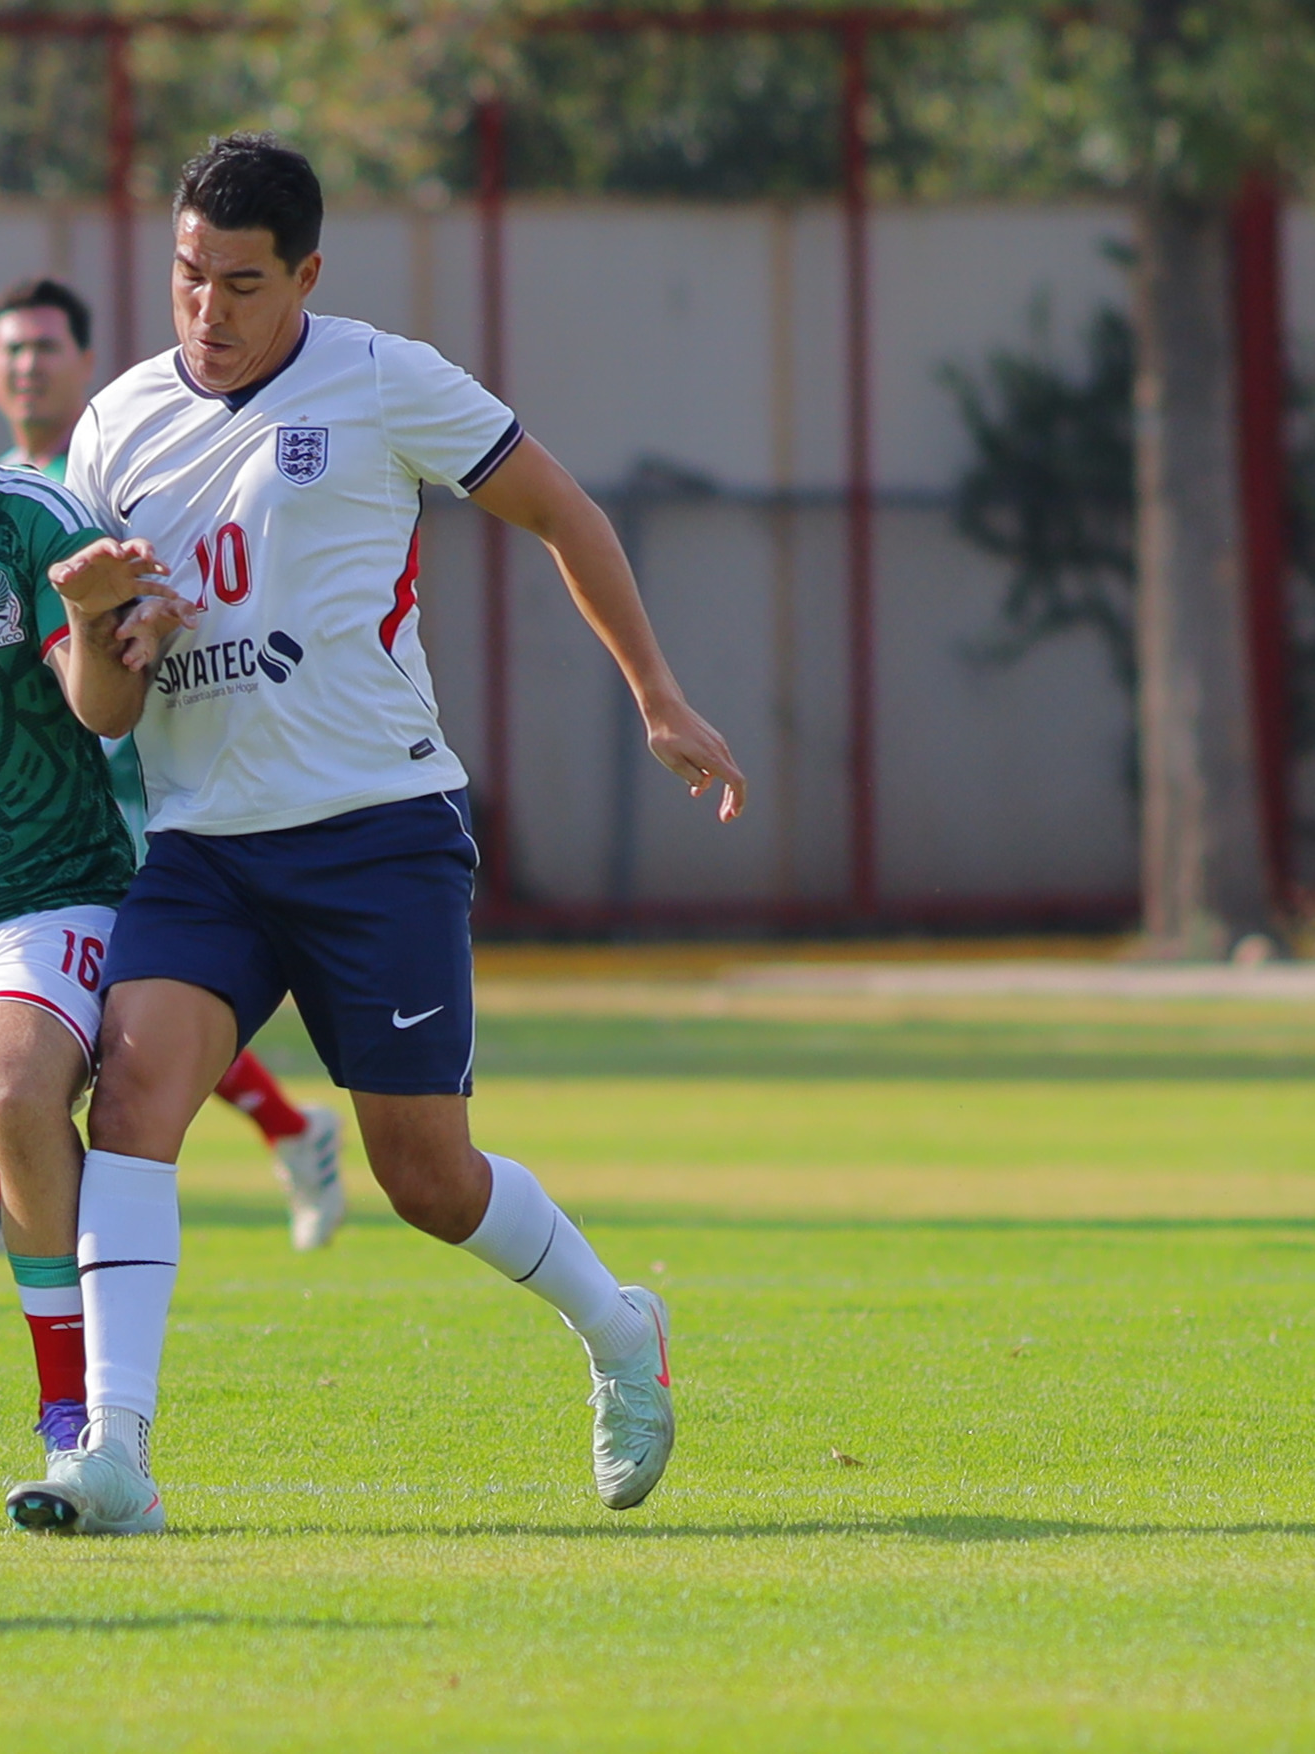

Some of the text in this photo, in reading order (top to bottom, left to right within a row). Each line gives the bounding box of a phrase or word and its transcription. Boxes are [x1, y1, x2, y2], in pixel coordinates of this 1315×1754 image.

[187, 522, 253, 613] 10
[154, 637, 257, 695] SAYATEC
[62, 929, 104, 993] 16
